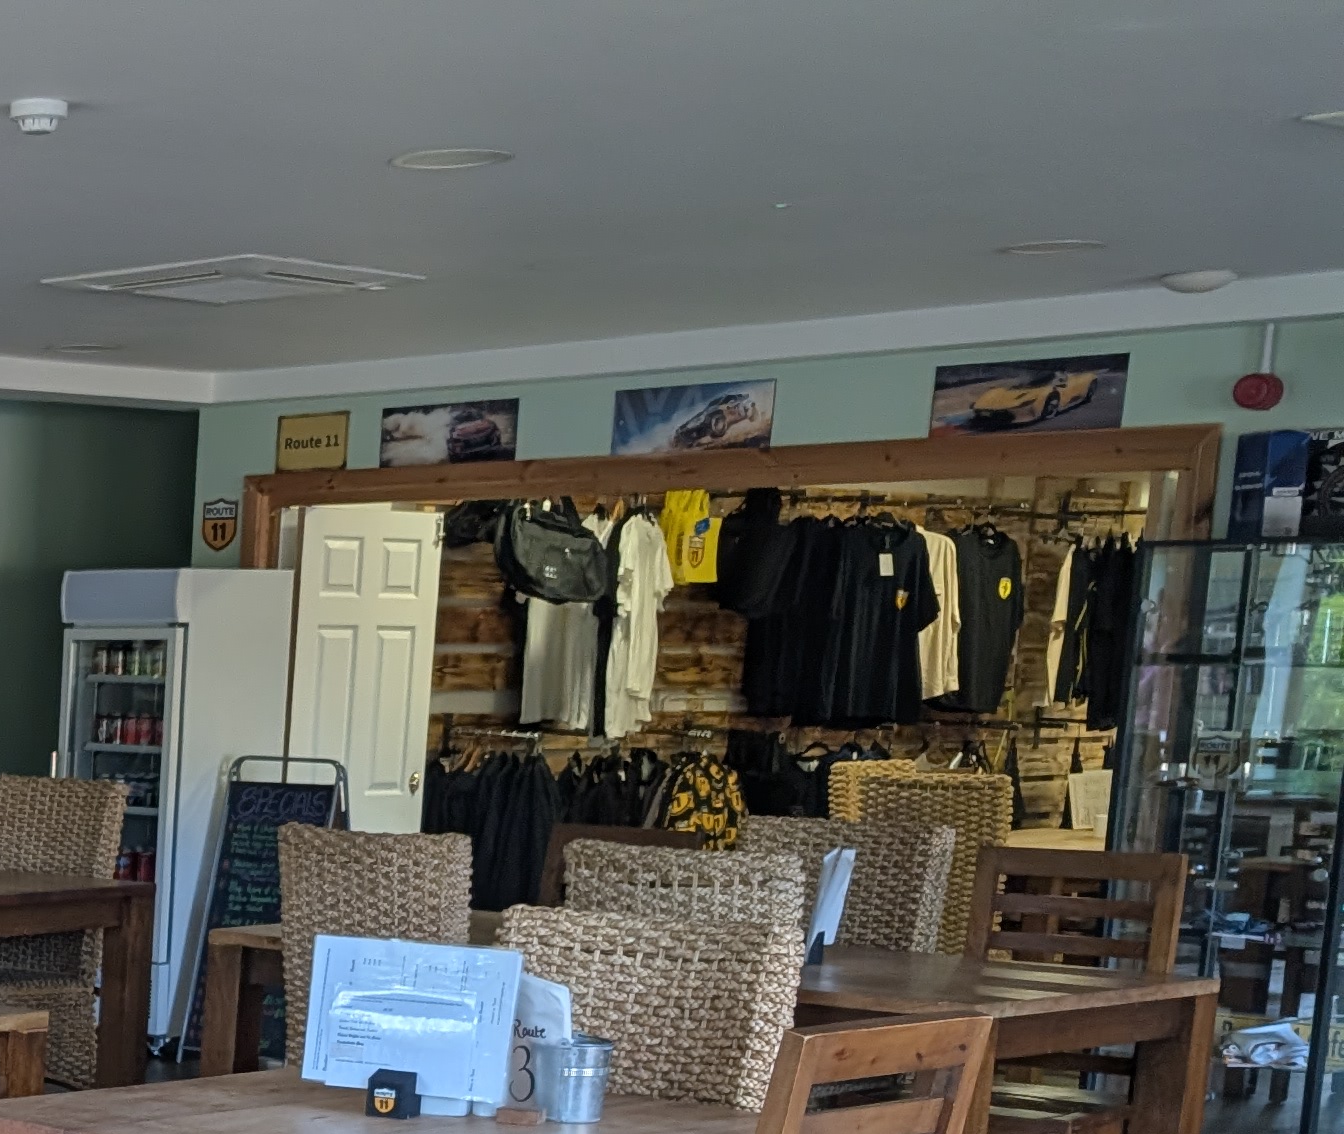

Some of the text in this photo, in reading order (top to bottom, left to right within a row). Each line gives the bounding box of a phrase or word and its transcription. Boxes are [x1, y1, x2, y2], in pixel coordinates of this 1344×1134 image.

[284, 434, 340, 450] Route 11
[205, 507, 235, 516] ROUTE
[211, 522, 227, 541] 11
[237, 786, 328, 817] SPECIALS
[513, 1018, 547, 1039] Route
[509, 1045, 535, 1102] 3
